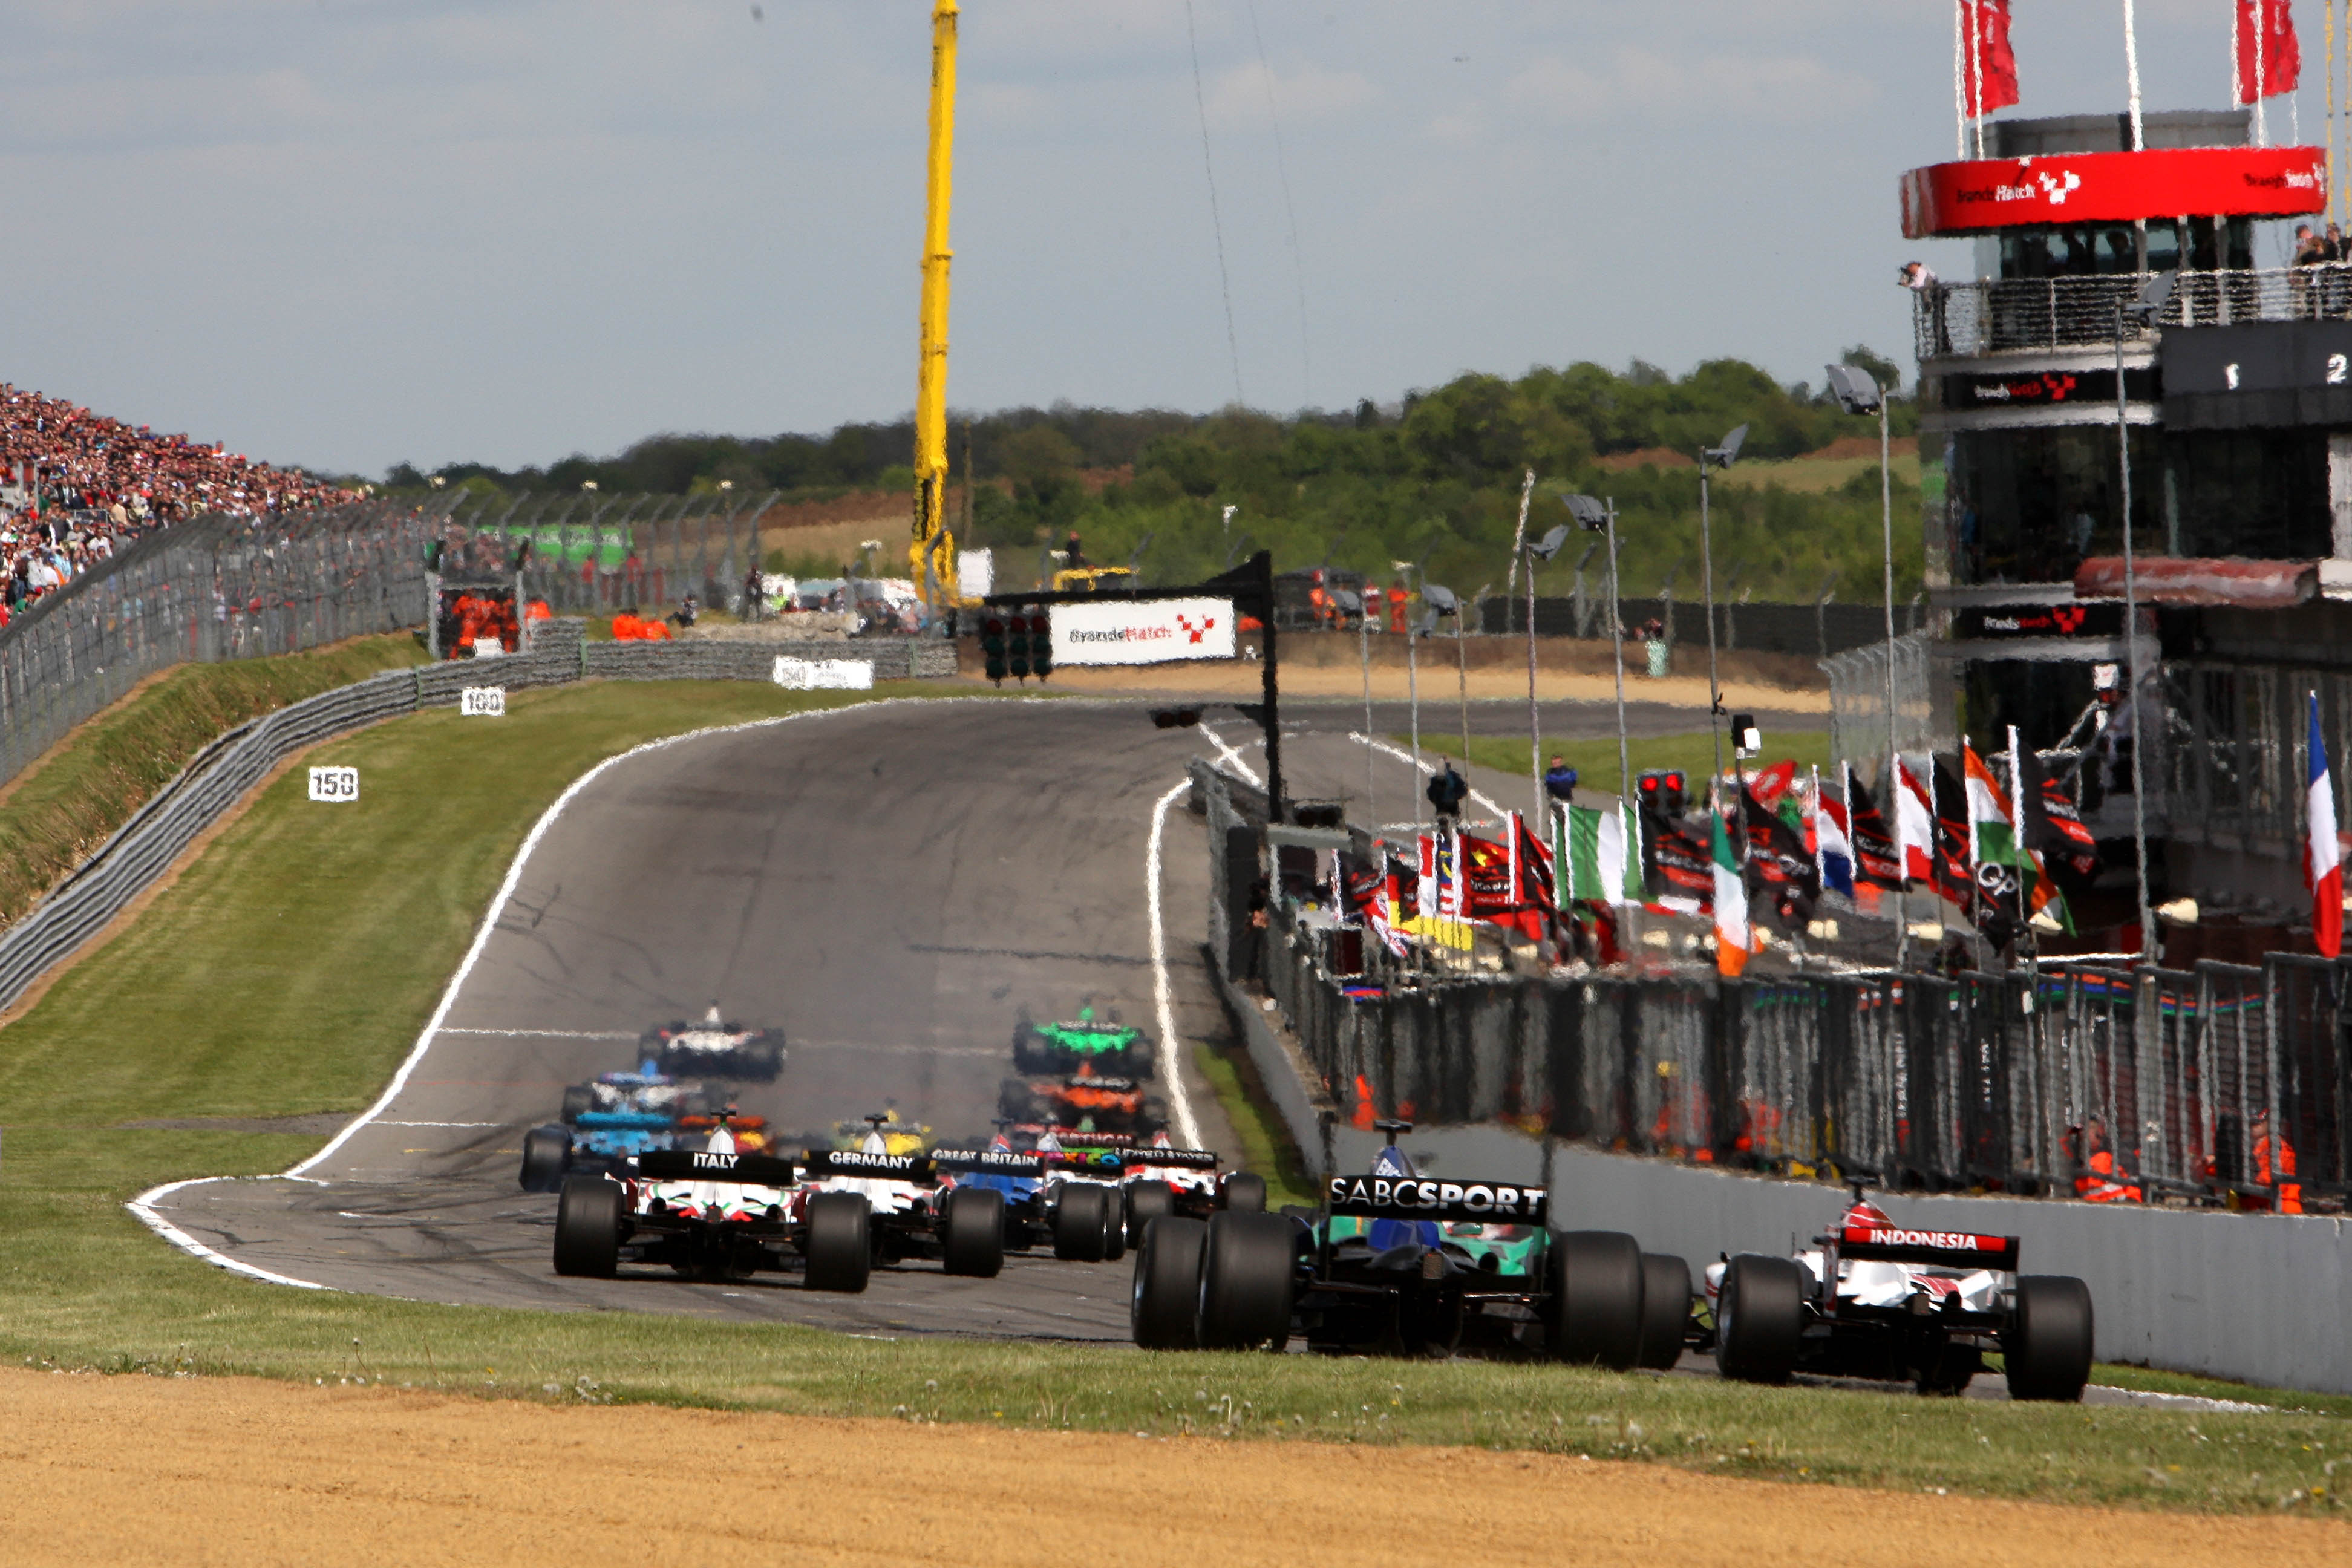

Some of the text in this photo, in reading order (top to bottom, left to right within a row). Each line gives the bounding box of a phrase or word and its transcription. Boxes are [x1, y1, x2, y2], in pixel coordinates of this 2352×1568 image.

[2223, 363, 2239, 390] 1
[2327, 353, 2347, 384] 2
[468, 691, 501, 711] 100
[313, 772, 354, 795] 150
[694, 1152, 739, 1169] ITALY
[829, 1151, 913, 1169] GERMANY
[931, 1149, 1039, 1166] GREAT BRITAIN
[1870, 1229, 1978, 1251] INDONESIA
